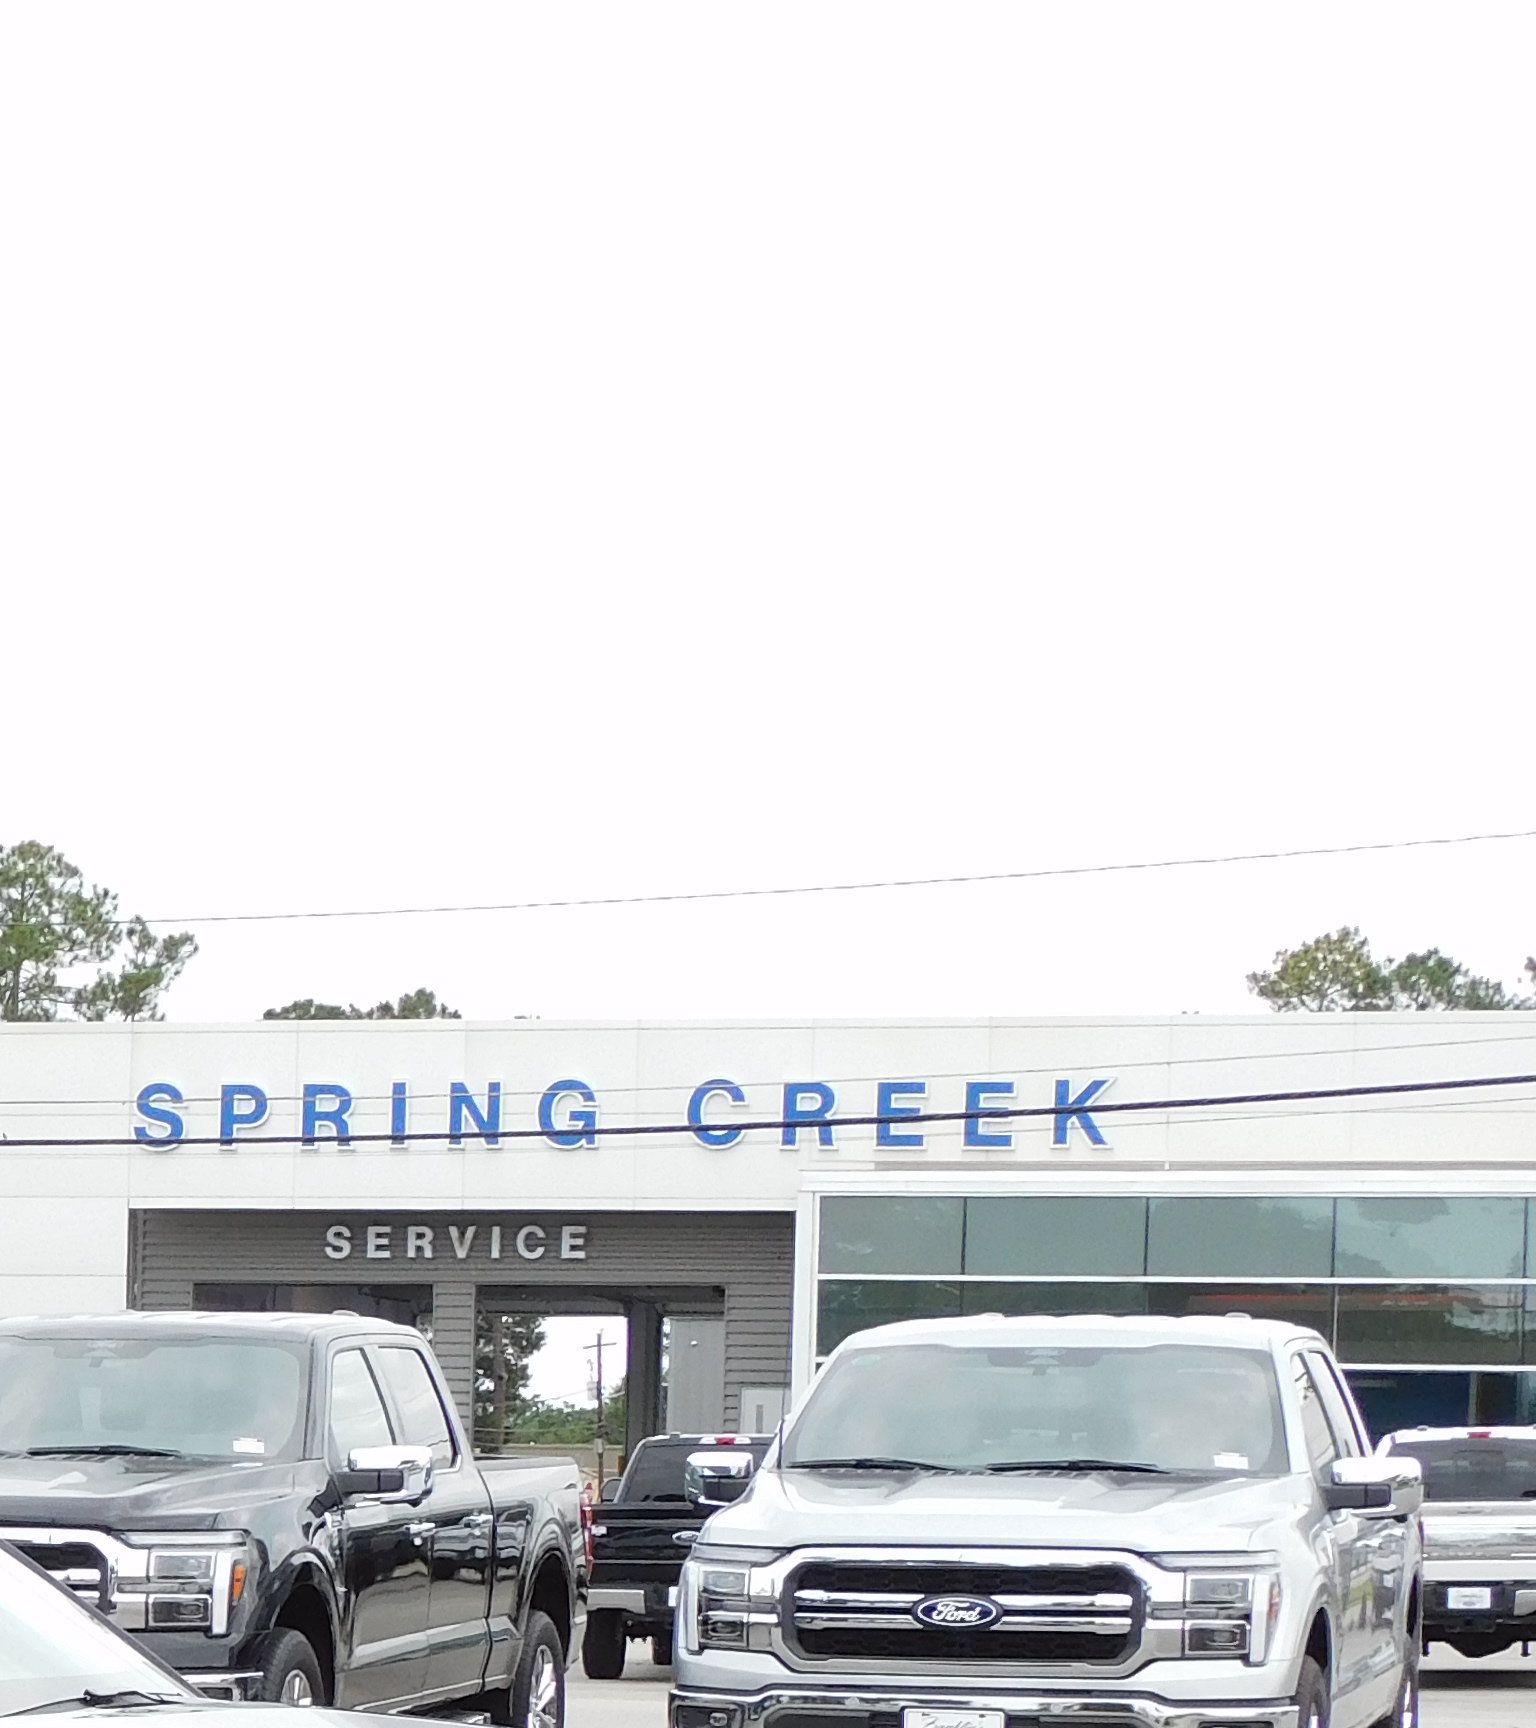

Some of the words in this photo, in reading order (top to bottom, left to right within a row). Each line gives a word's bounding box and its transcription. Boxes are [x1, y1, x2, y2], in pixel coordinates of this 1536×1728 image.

[132, 1078, 601, 1151] SPRING
[686, 1077, 1115, 1151] CREEK
[324, 1225, 589, 1260] SERVICE
[932, 1601, 982, 1621] Ford
